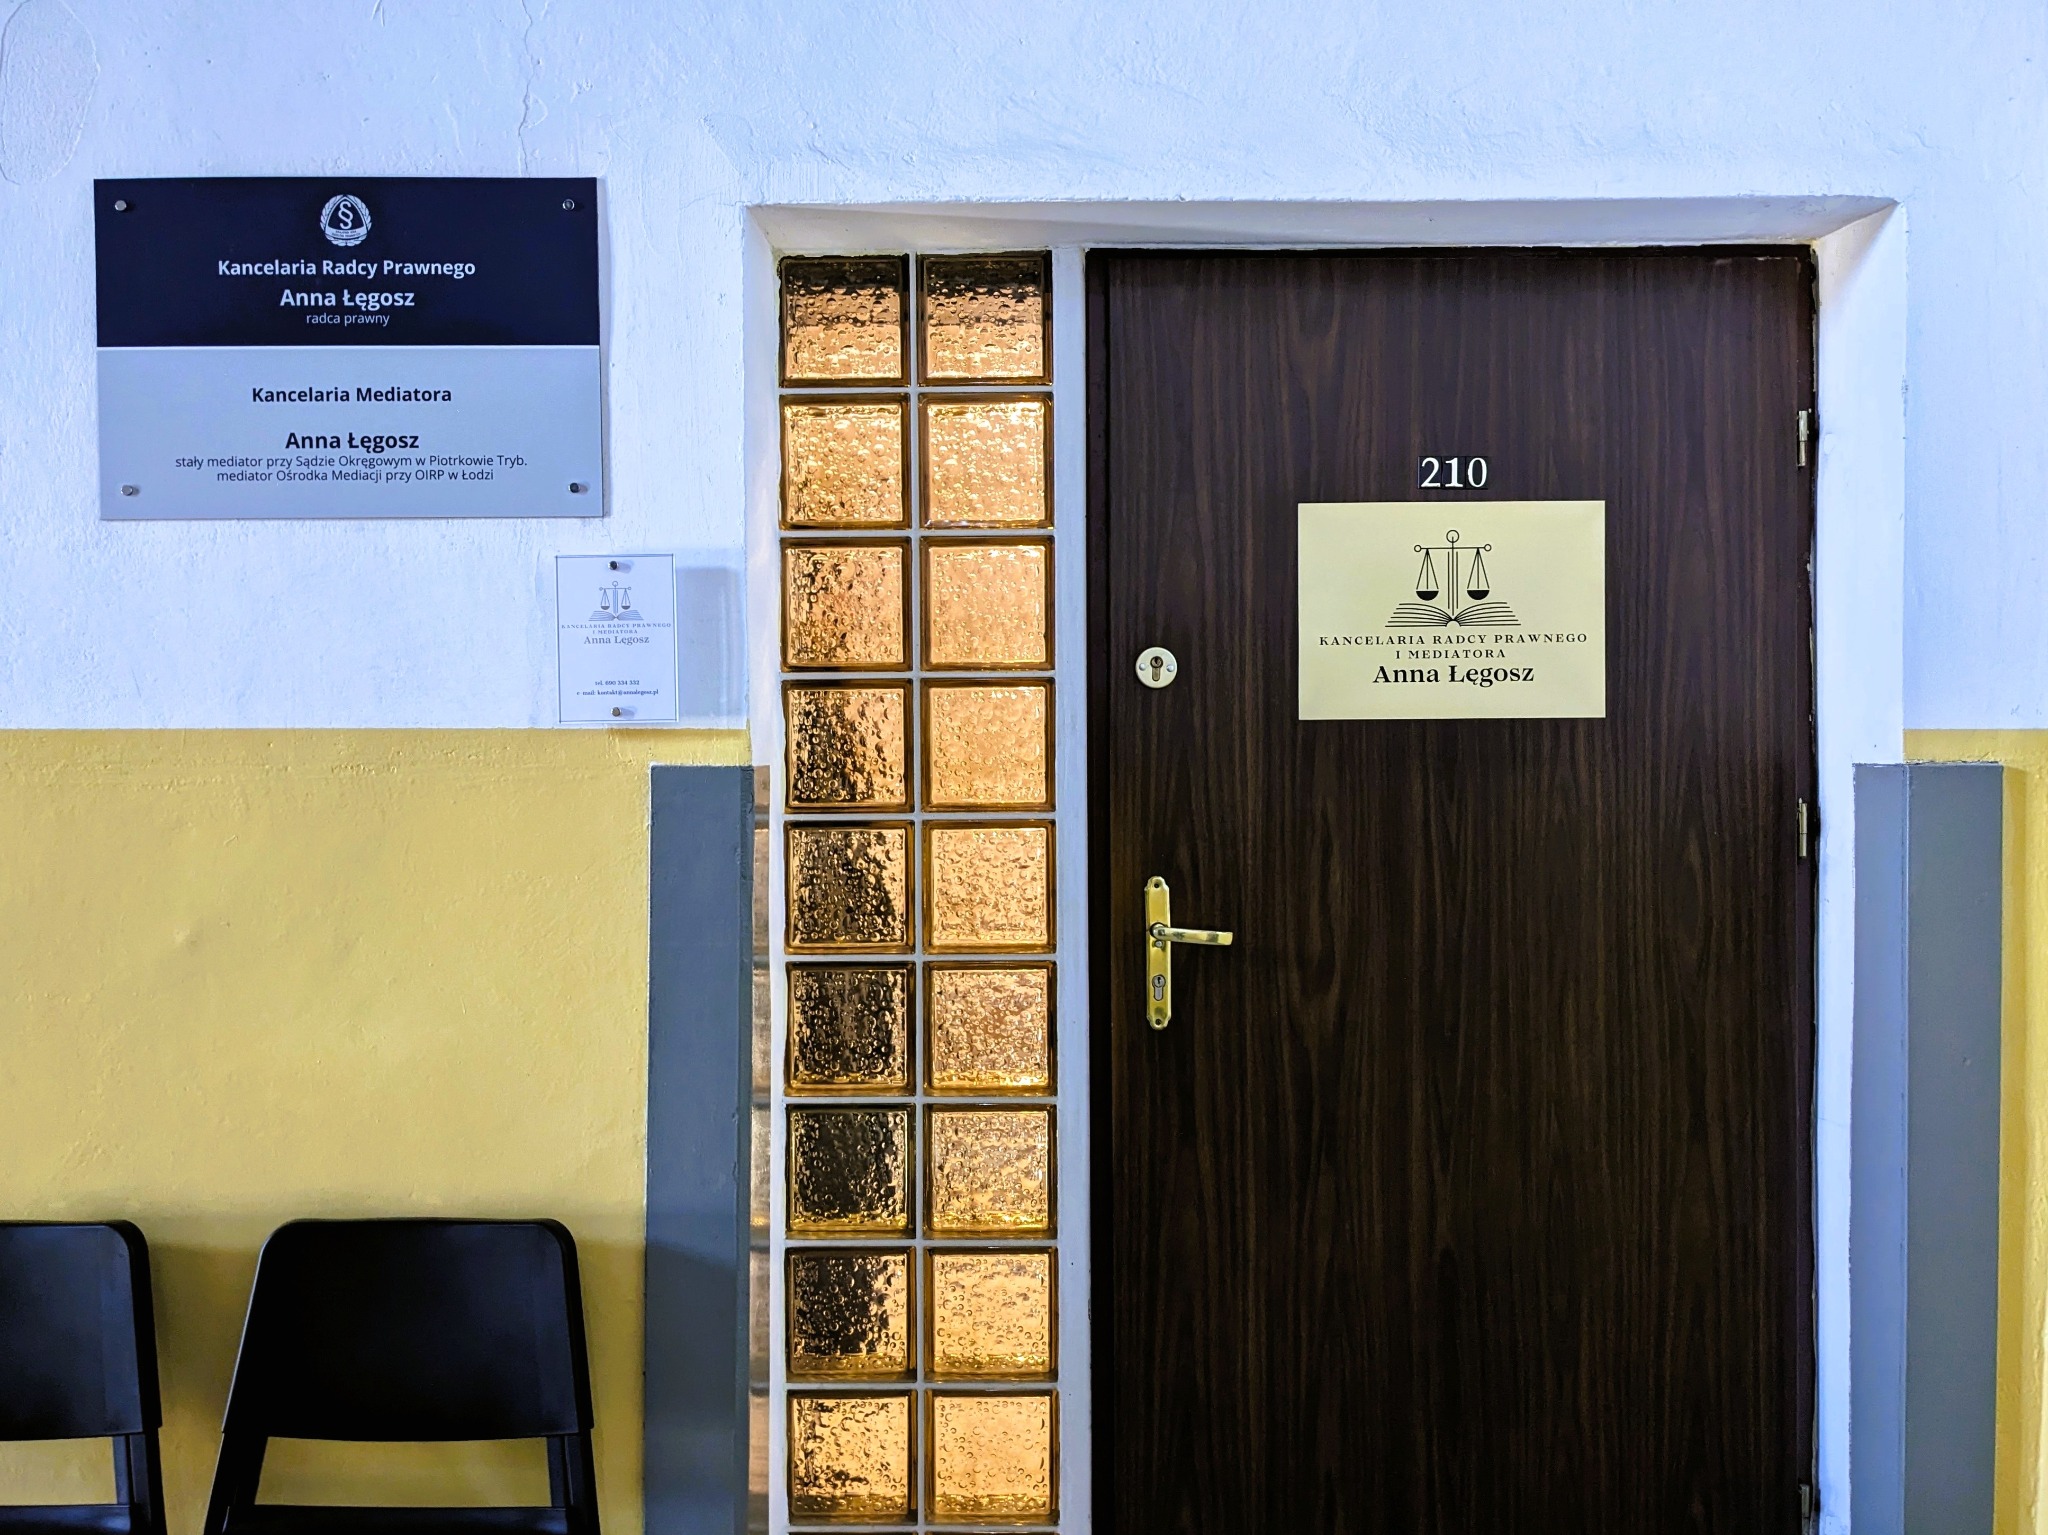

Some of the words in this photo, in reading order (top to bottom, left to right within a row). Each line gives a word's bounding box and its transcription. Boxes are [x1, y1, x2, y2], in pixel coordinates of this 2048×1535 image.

[218, 259, 317, 275] Kancelaria
[322, 259, 378, 279] Radcy
[383, 260, 476, 279] Prawnego
[280, 289, 336, 307] Anna
[342, 288, 415, 311] Łęgosz
[306, 312, 341, 324] radca
[344, 314, 390, 327] prawny
[252, 386, 350, 402] Kancelaria
[356, 386, 452, 402] Mediatora
[285, 432, 341, 450] Anna
[347, 431, 420, 453] Łęgosz
[175, 456, 204, 470] stały
[207, 456, 263, 468] mediator
[266, 457, 293, 470] przy
[296, 455, 335, 470] Sądzie
[338, 455, 412, 470] Okręgowym
[415, 458, 426, 466] w
[429, 454, 494, 467] Piotrkowie
[497, 455, 528, 469] Tryb.
[217, 470, 273, 482] mediator
[276, 469, 328, 482] Ośrodka
[332, 469, 382, 484] Mediacji
[385, 471, 412, 484] przy
[415, 470, 445, 481] OIRP
[448, 472, 459, 481] w
[461, 468, 494, 481] Łodzi
[1420, 456, 1488, 488] 210
[583, 636, 611, 645] Anna
[1319, 635, 1426, 646] KANCELARIA
[1432, 634, 1487, 645] RADCY
[1494, 633, 1588, 644] PRAWNEGO
[1396, 650, 1401, 660] I
[1408, 649, 1506, 659] MEDIATORA
[1373, 665, 1440, 684] Anna
[1449, 664, 1535, 688] Łęgosz
